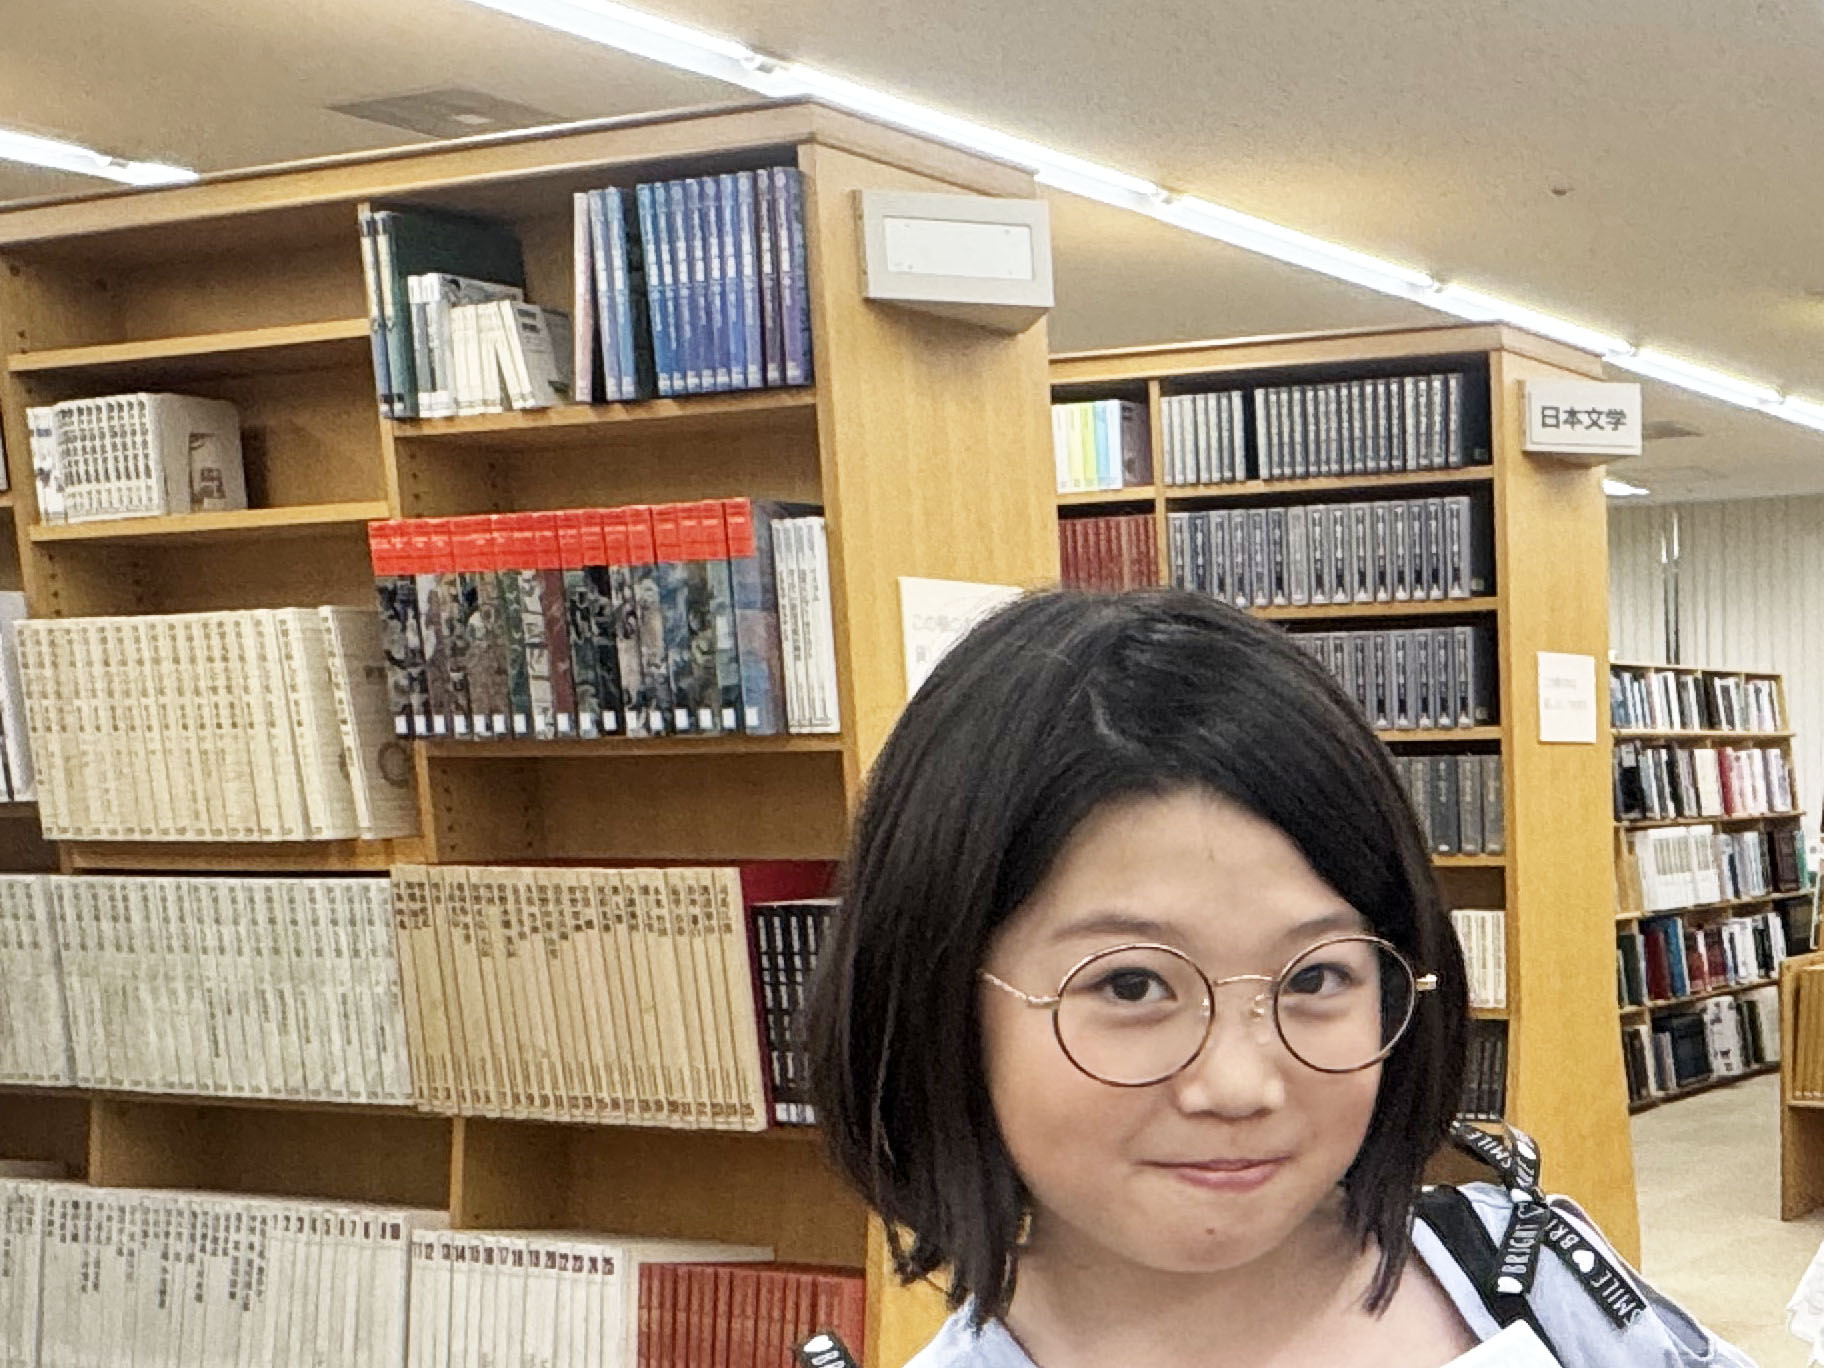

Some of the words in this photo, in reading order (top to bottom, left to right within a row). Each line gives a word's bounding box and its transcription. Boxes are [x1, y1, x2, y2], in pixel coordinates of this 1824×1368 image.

[1541, 405, 1627, 432] 日本文学
[1590, 1269, 1642, 1326] SMILE
